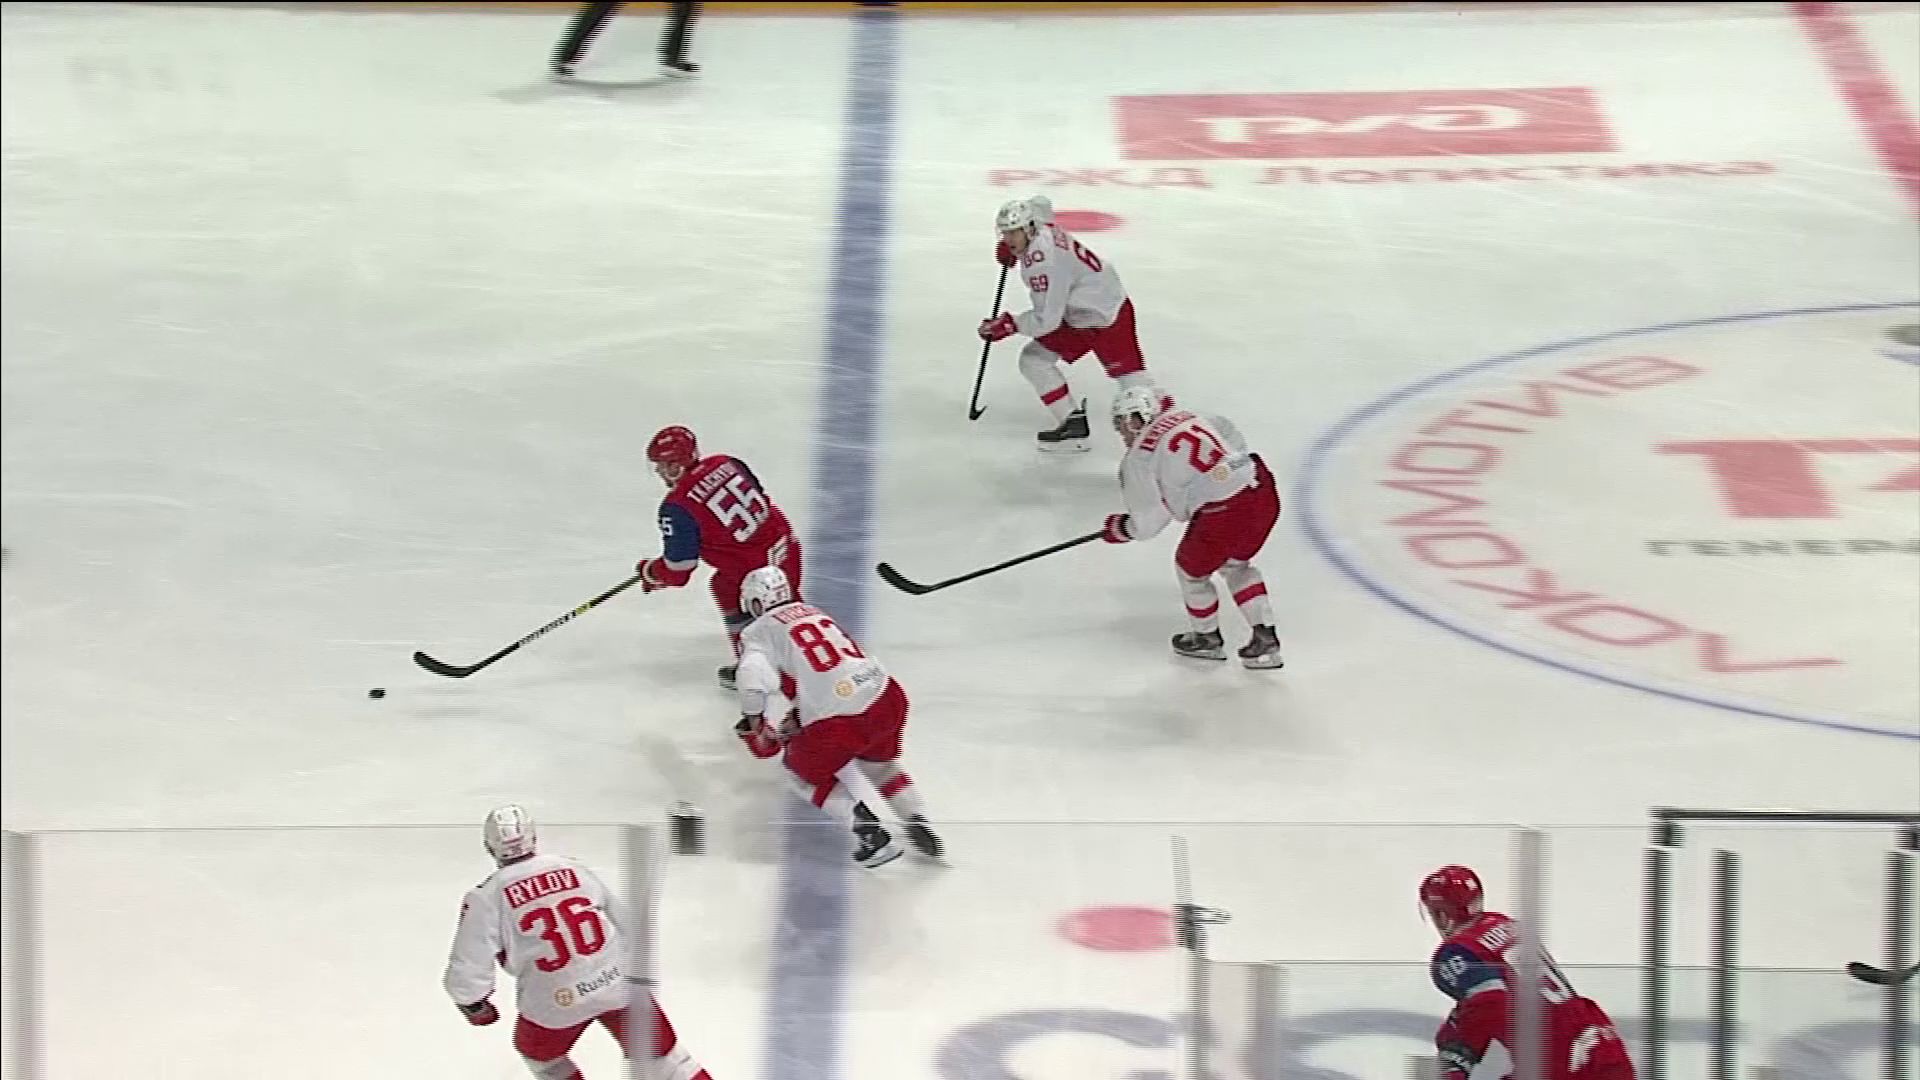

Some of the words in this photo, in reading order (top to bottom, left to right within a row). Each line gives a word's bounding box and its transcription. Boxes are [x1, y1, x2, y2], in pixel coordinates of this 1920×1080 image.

[986, 166, 1213, 190] РЖД
[1250, 160, 1775, 186] Логистика
[1029, 273, 1049, 293] 69
[1167, 423, 1228, 474] 21
[705, 474, 770, 543] 55
[1376, 355, 1842, 674] ЛОКОМОТИВ
[789, 618, 865, 673] 83
[505, 868, 578, 908] RYLOV
[518, 895, 607, 973] 36
